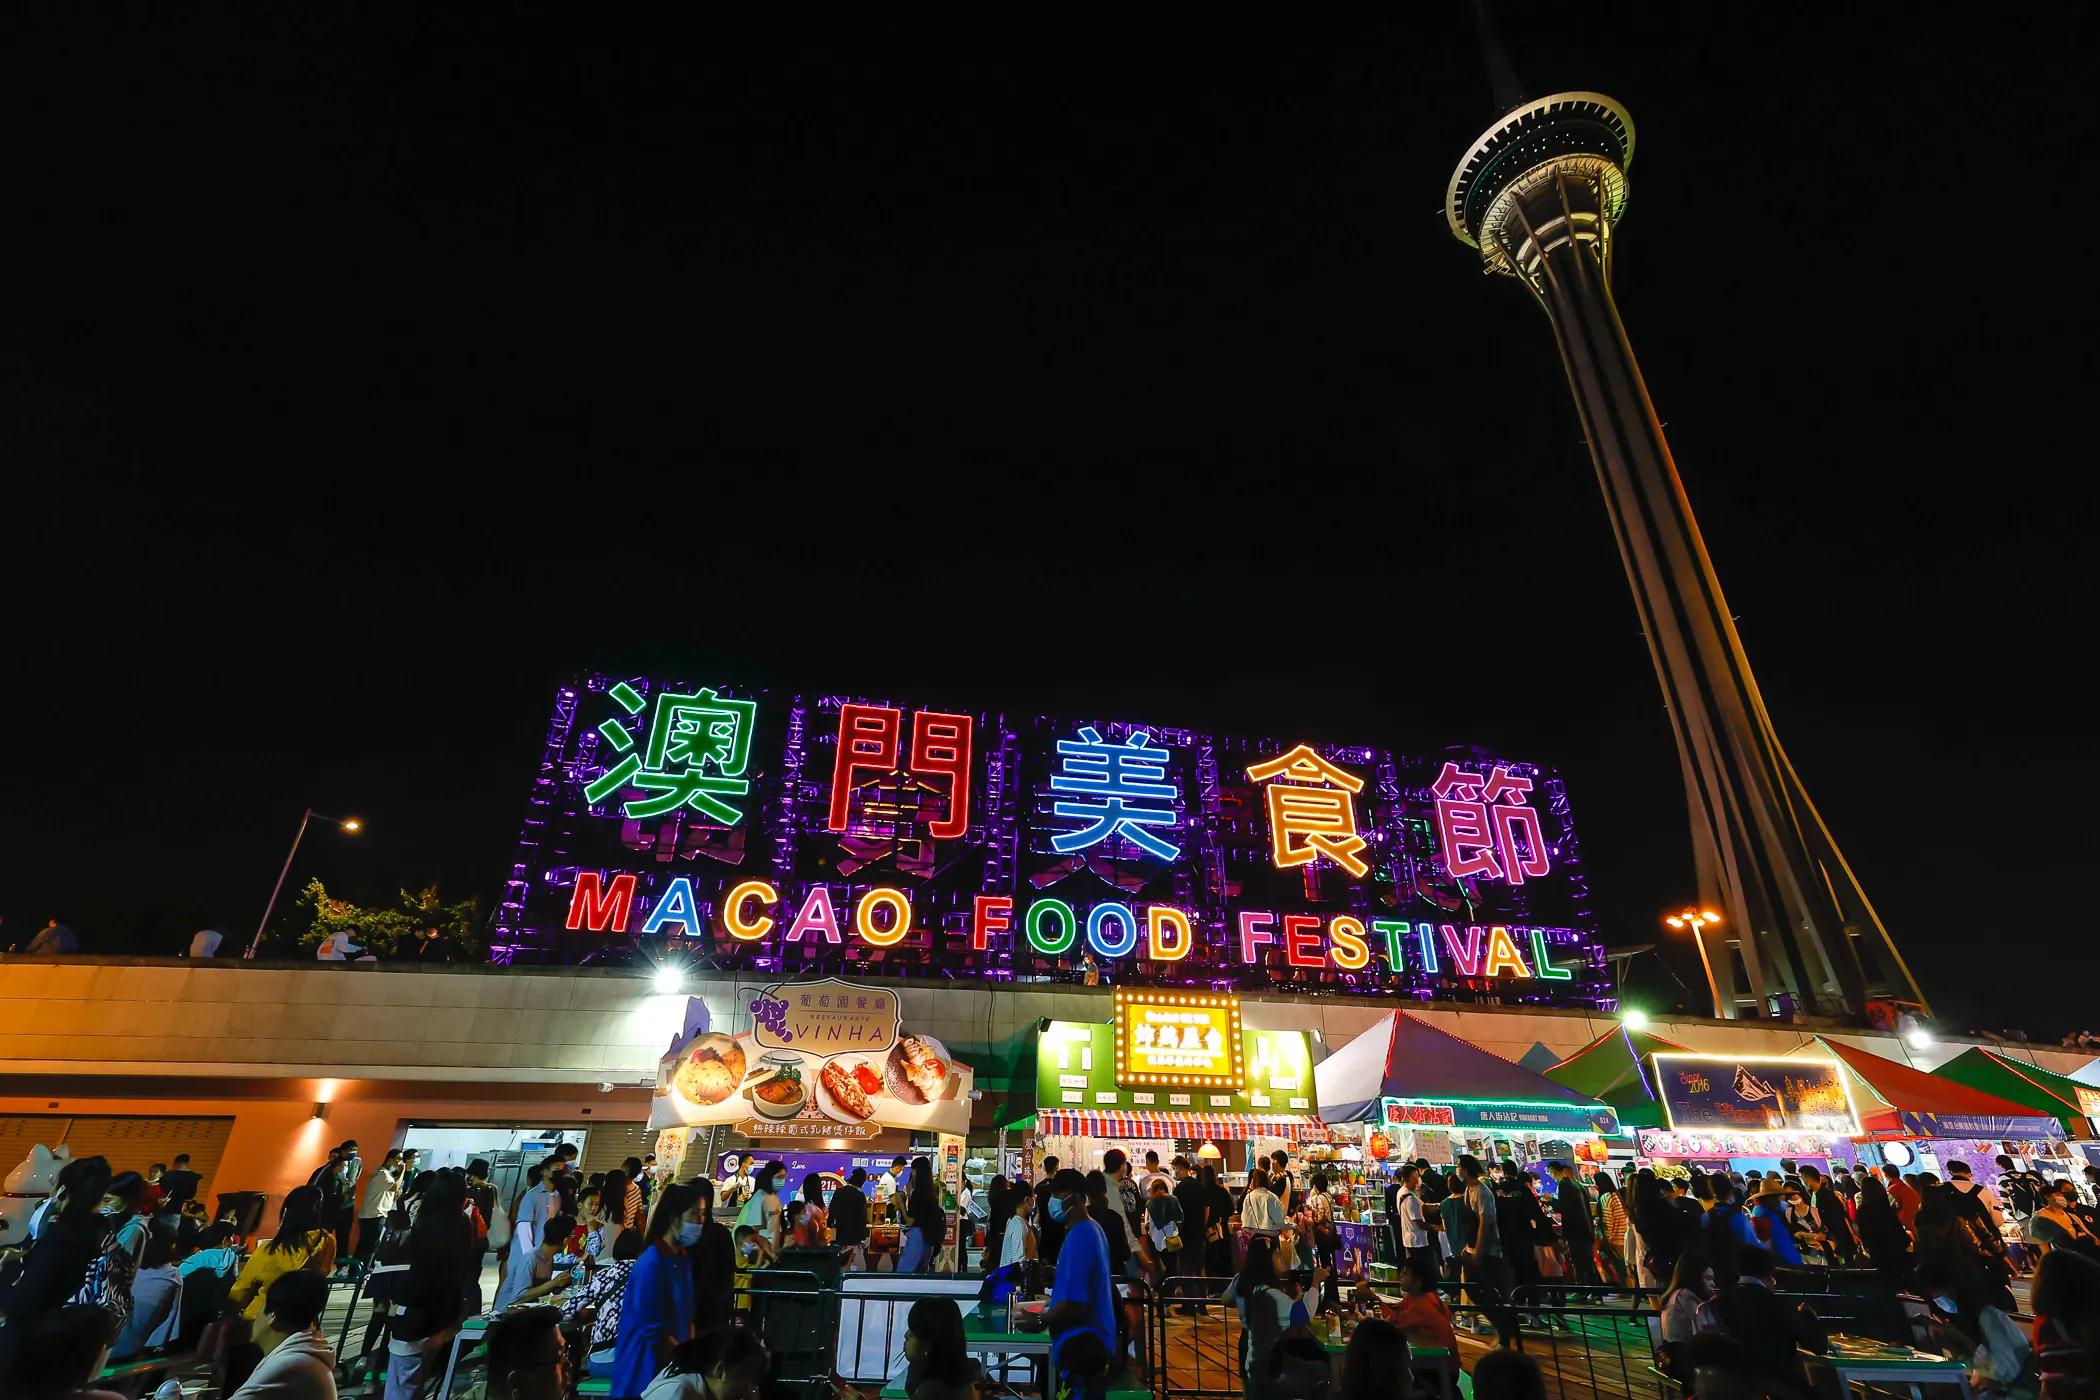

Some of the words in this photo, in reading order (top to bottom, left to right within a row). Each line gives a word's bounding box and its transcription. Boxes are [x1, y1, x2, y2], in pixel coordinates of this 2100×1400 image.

[583, 680, 1552, 887] 澳門美食節
[565, 872, 913, 947] MACAO
[973, 895, 1193, 961] FOOD
[1238, 909, 1573, 982] FESTIVAL
[795, 1023, 884, 1042] VINHA
